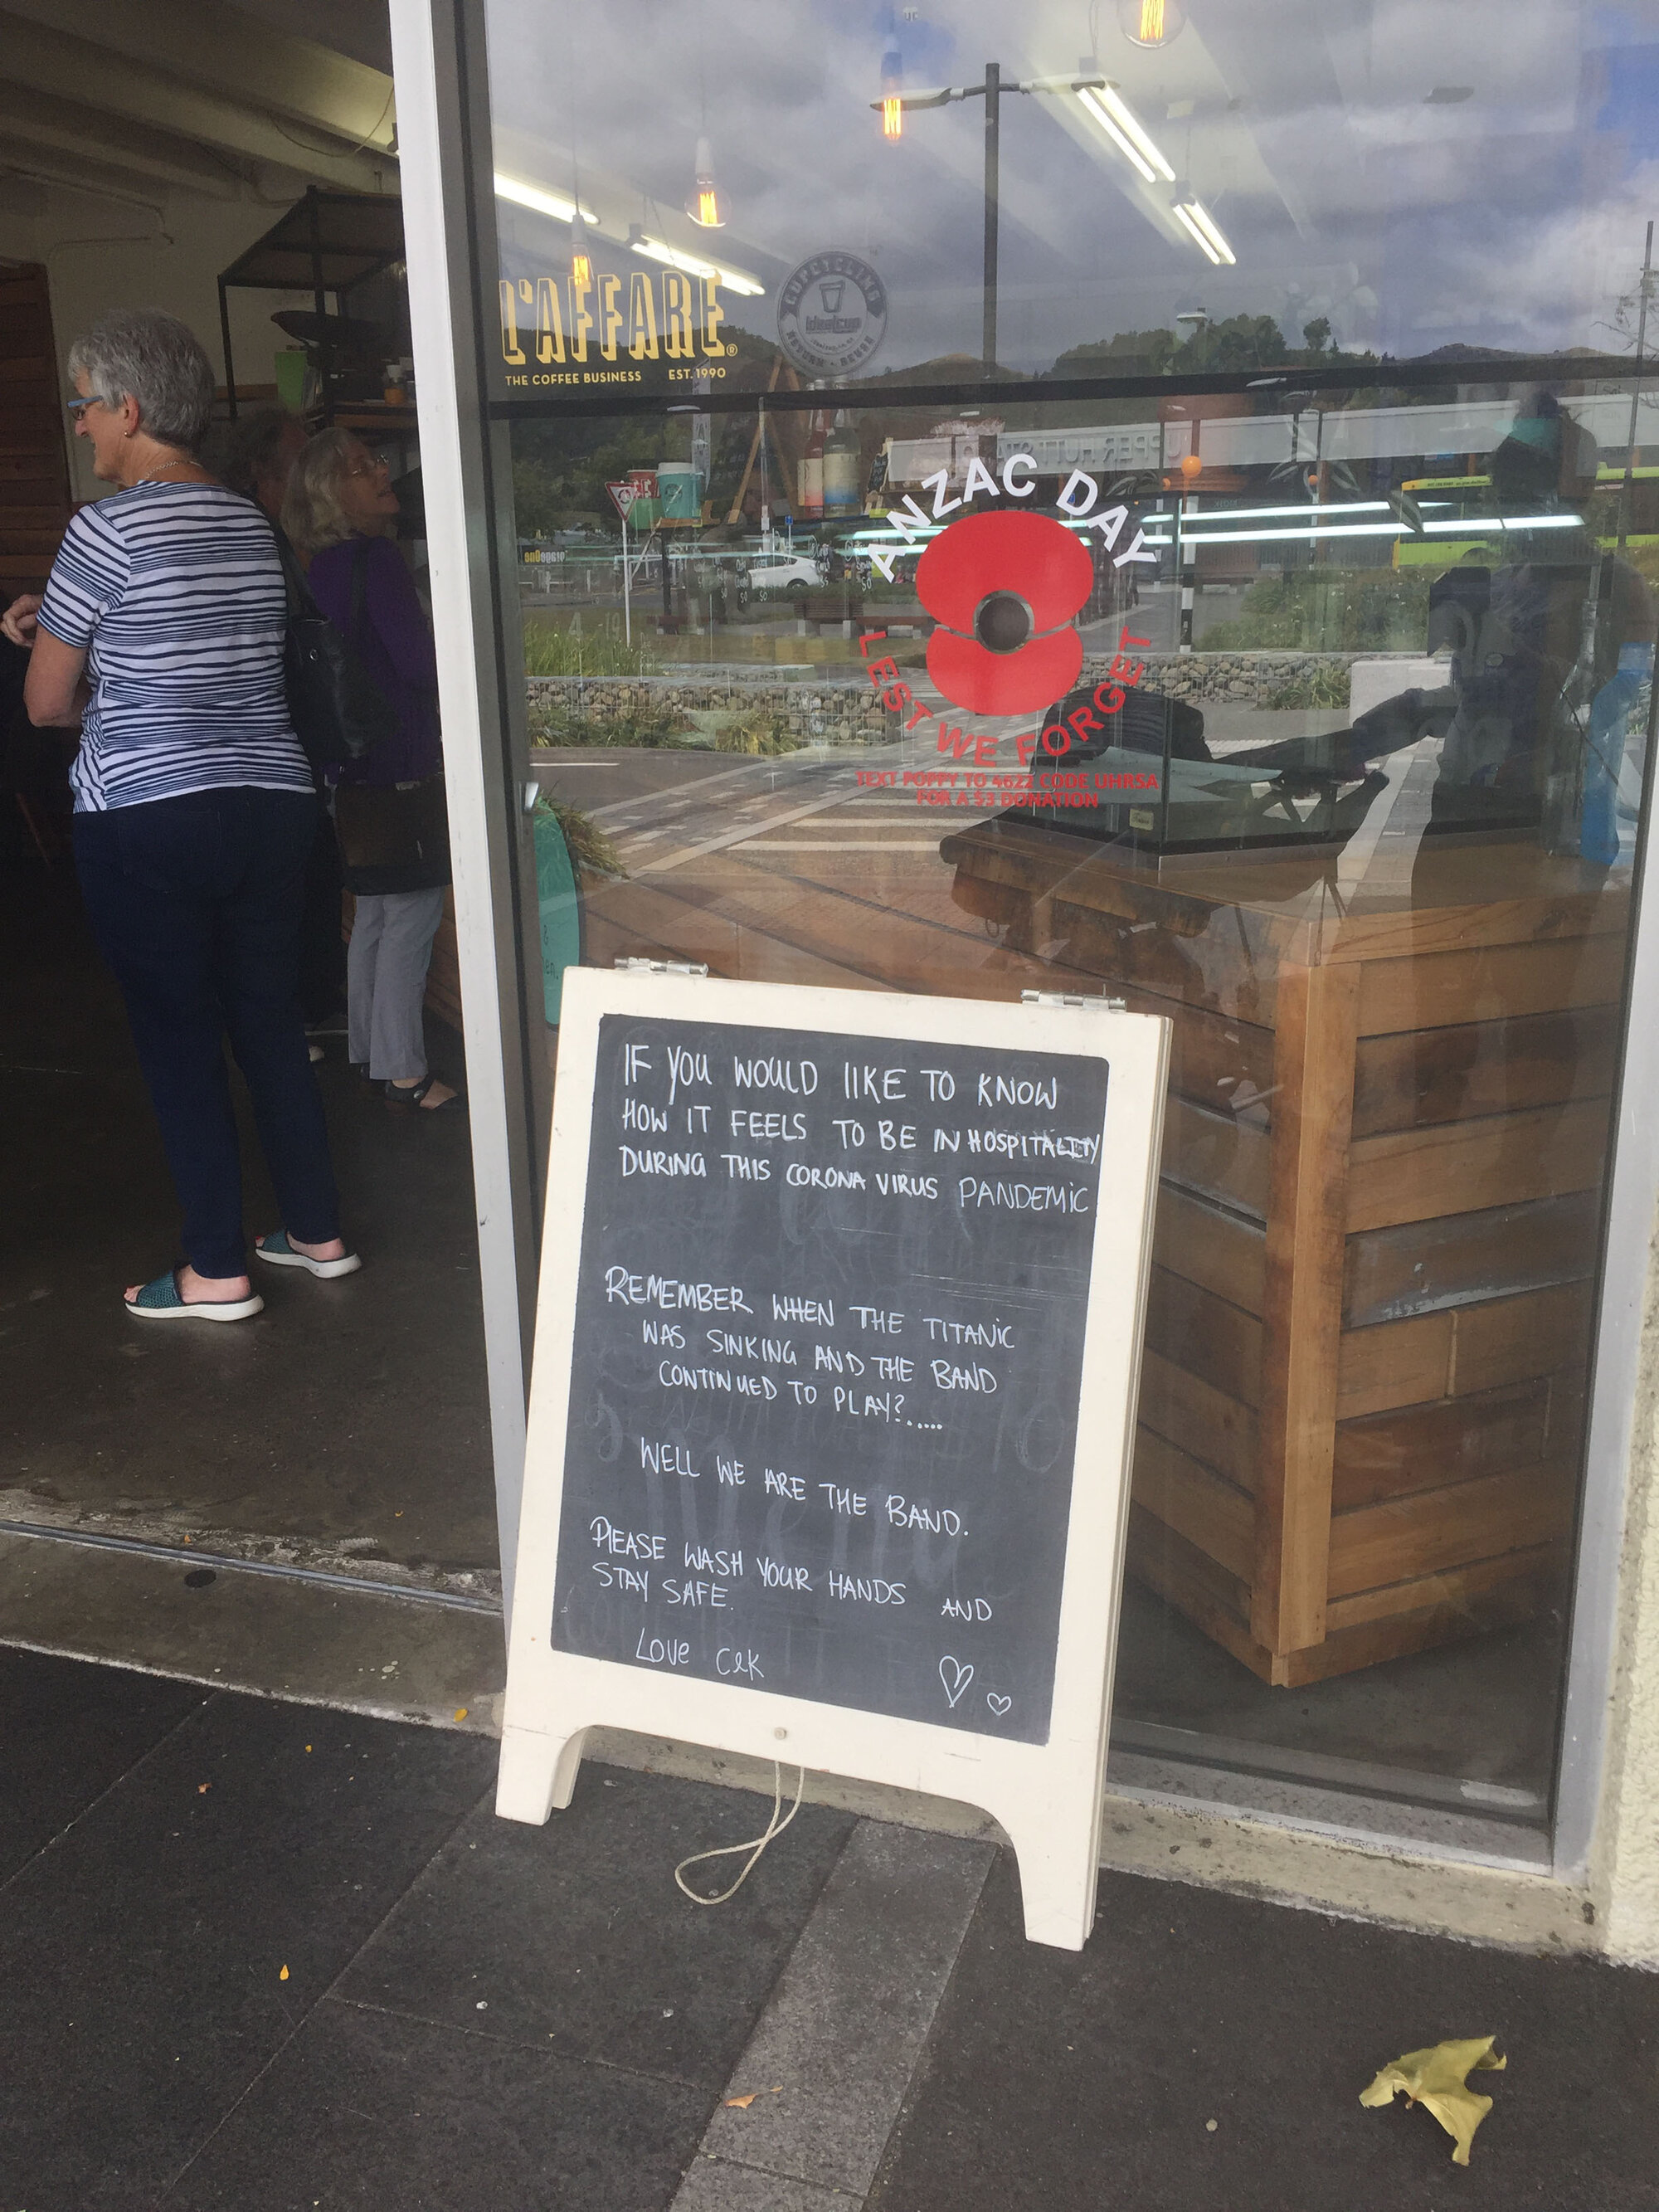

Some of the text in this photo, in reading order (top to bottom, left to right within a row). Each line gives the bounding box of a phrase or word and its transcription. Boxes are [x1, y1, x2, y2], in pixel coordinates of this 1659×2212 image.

[505, 368, 726, 386] THE COFFEE BUSINESS EST. 1990
[868, 453, 1157, 584] ANZAC DAY
[859, 626, 1151, 767] LEST WE FORGET
[854, 771, 1159, 790] TEXT POPPY TO 4622 CODE UHRSA
[917, 789, 1098, 808] FOR A $3 DONATION
[625, 1044, 652, 1085] IF
[668, 1045, 712, 1105] YOU
[734, 1056, 817, 1095] WOULD
[920, 1070, 955, 1101] TO
[978, 1074, 1057, 1109] KNOW
[622, 1099, 1099, 1164] HOW IT FEELS TO BE IN HOSPITALITY
[619, 1145, 706, 1177] DURING
[721, 1155, 771, 1181] THIS
[786, 1164, 866, 1191] CORONA
[875, 1173, 937, 1199] VIRUS
[605, 1266, 753, 1314] REMEMBER
[773, 1294, 834, 1327] WHEN
[849, 1307, 904, 1333] THE
[643, 1319, 997, 1393] WAS SINKING AND THE BAND
[787, 1381, 816, 1405] TO
[641, 1437, 968, 1536] WELL WE ARE THE BAND.
[592, 1562, 734, 1610] STAY SAFE.
[685, 1542, 742, 1576] WASH
[757, 1557, 813, 1591] YOUR
[829, 1570, 906, 1604] HANDS
[941, 1598, 992, 1621] AND
